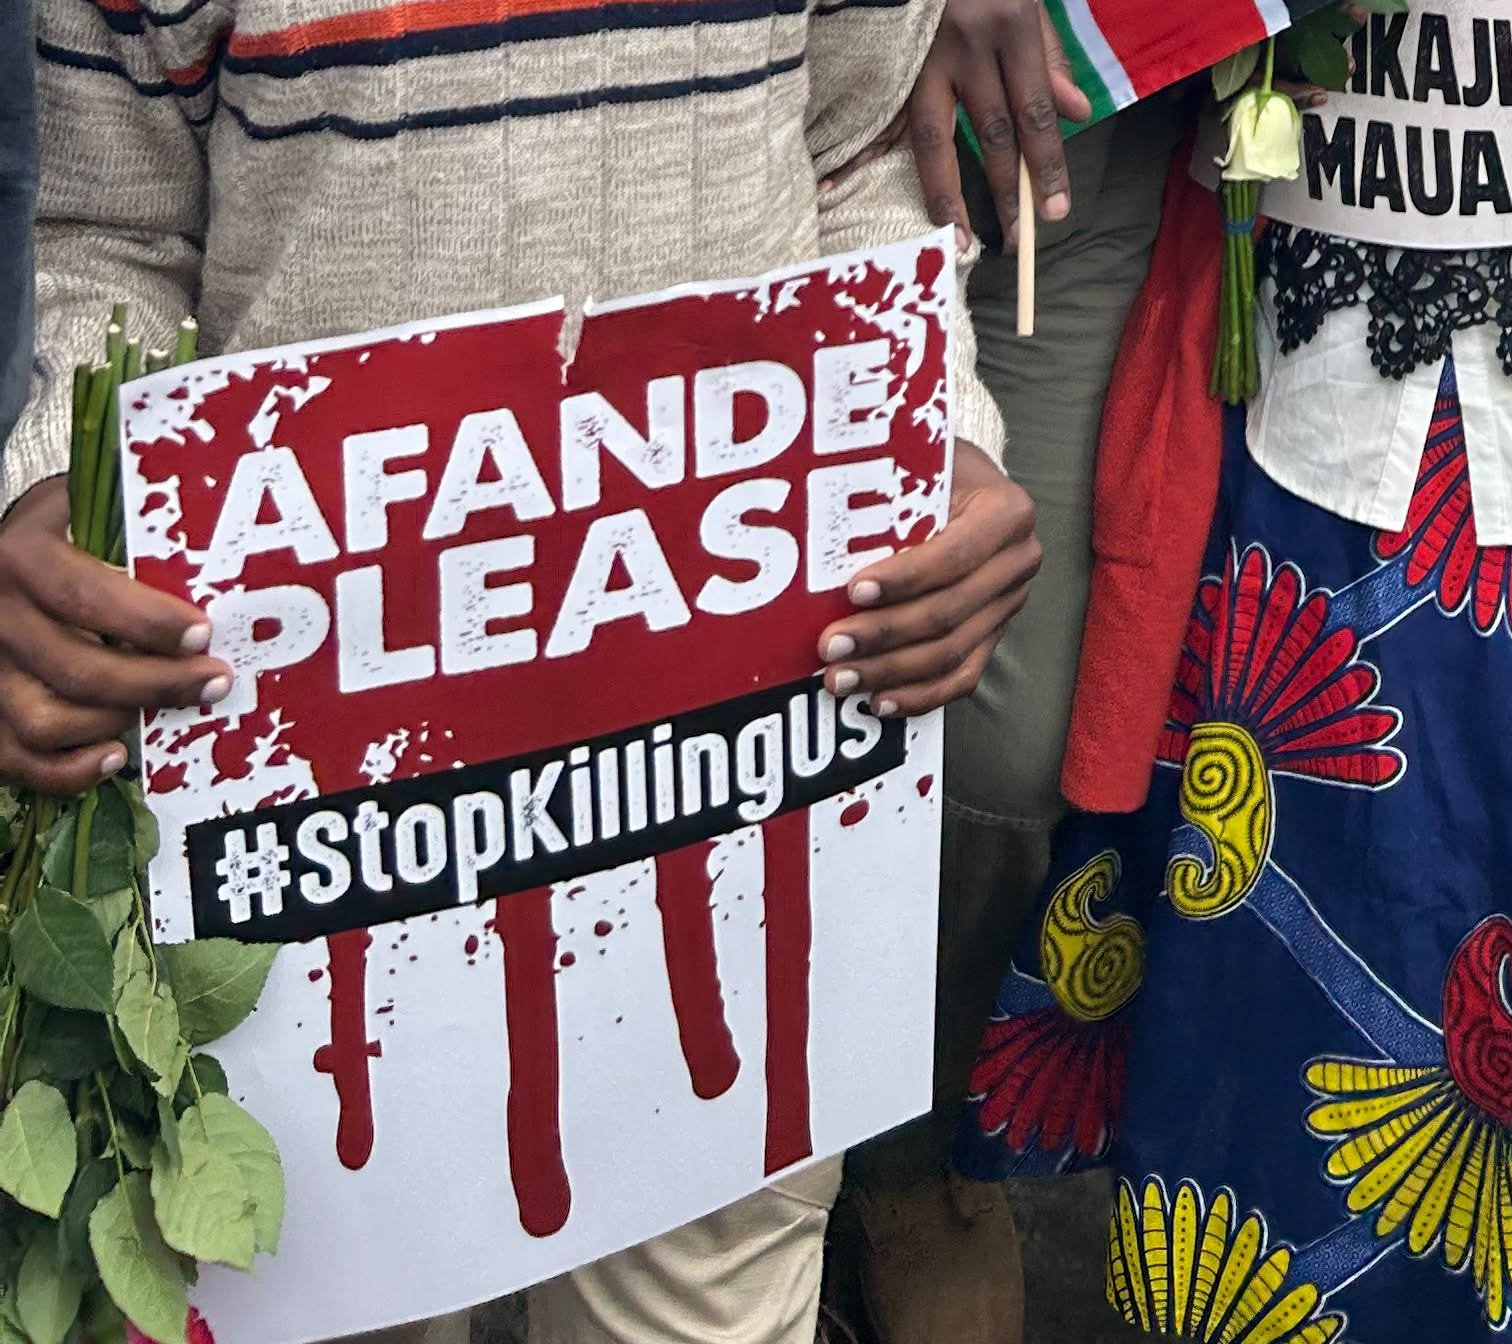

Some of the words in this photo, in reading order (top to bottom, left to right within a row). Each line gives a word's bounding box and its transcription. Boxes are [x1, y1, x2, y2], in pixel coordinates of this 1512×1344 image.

[197, 338, 892, 583] AFANDE
[203, 460, 902, 716] PLEASE
[216, 691, 882, 924] #StopKillingUs
